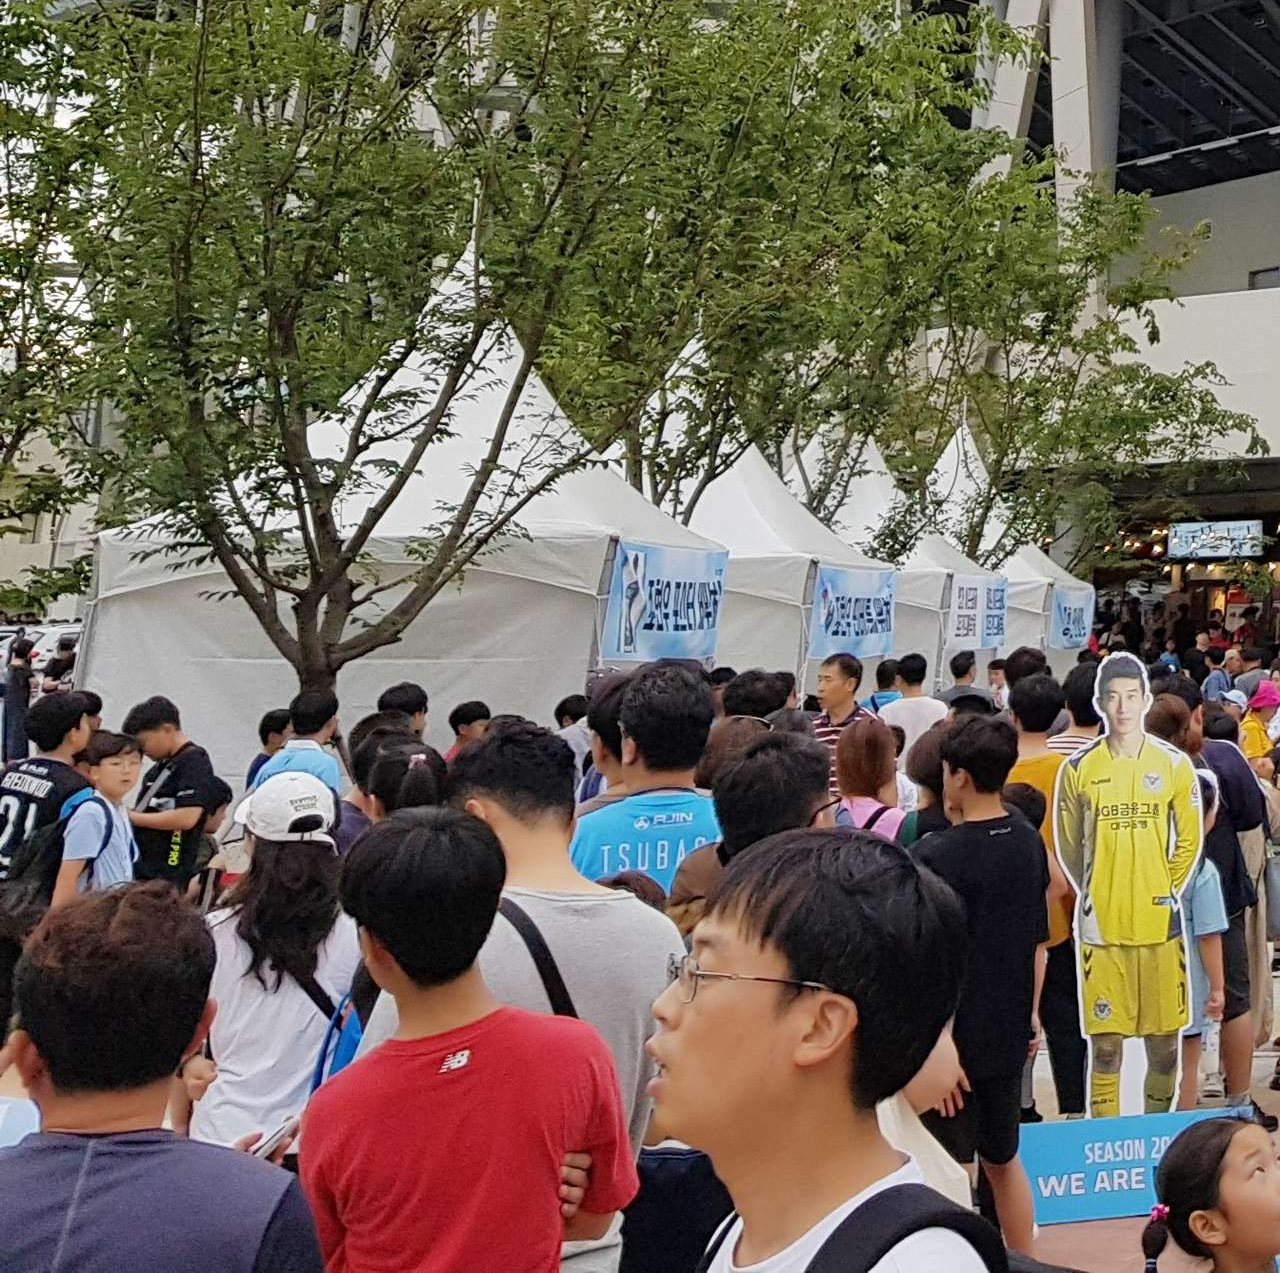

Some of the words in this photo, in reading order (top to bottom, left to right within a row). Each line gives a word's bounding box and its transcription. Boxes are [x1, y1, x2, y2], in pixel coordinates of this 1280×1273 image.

[1084, 1138, 1145, 1165] SEASON
[1151, 1135, 1171, 1160] 20
[1037, 1173, 1087, 1198] WE
[1094, 1167, 1146, 1194] ARE
